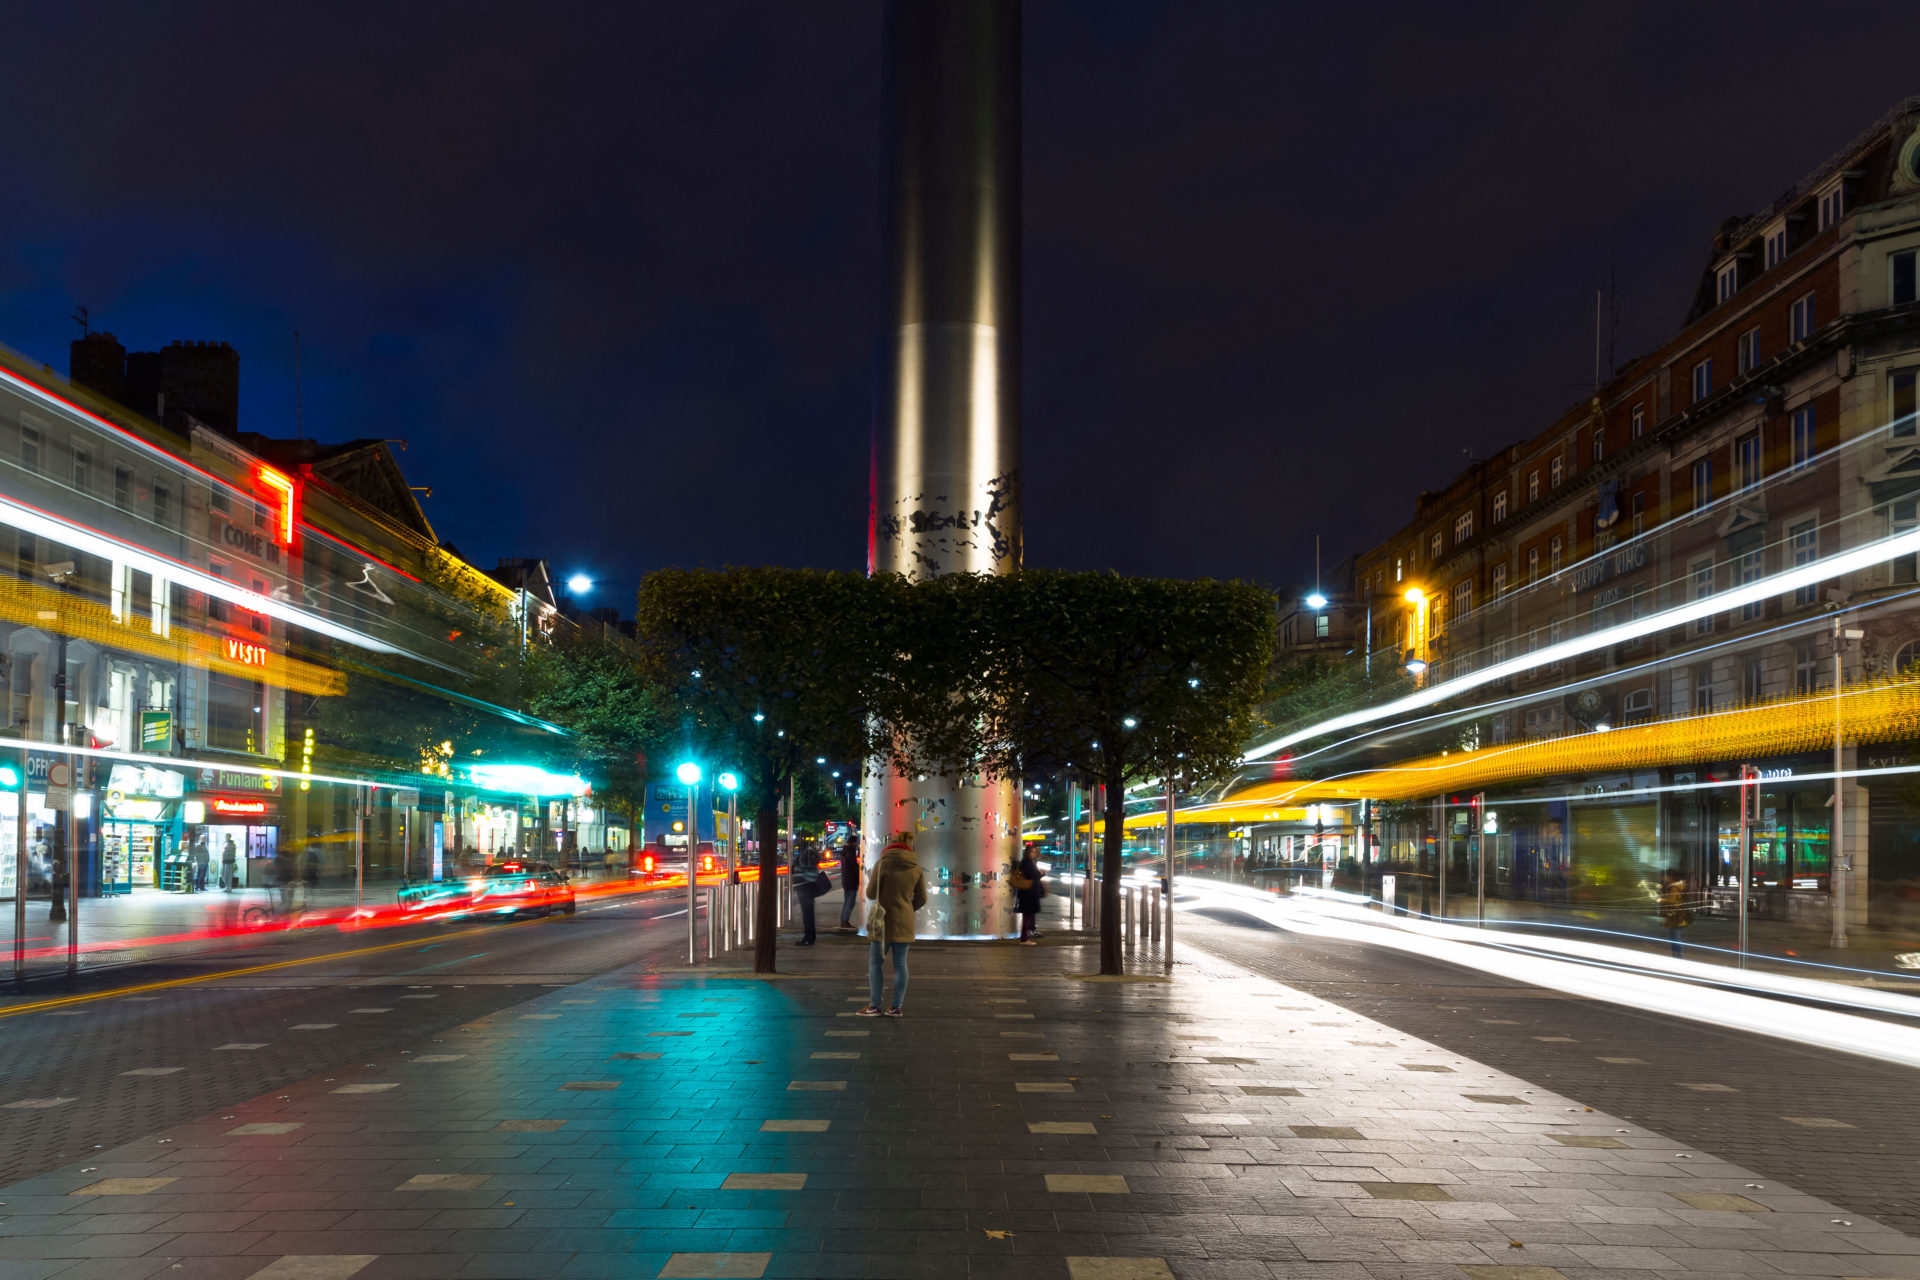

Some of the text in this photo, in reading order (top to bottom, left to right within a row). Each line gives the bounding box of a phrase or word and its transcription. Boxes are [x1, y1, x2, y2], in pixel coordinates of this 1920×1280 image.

[224, 525, 280, 564] COME IN
[1575, 560, 1607, 592] HAPPY
[228, 639, 267, 666] VISIT
[299, 728, 314, 791] FUNLAD
[219, 769, 264, 789] Funland
